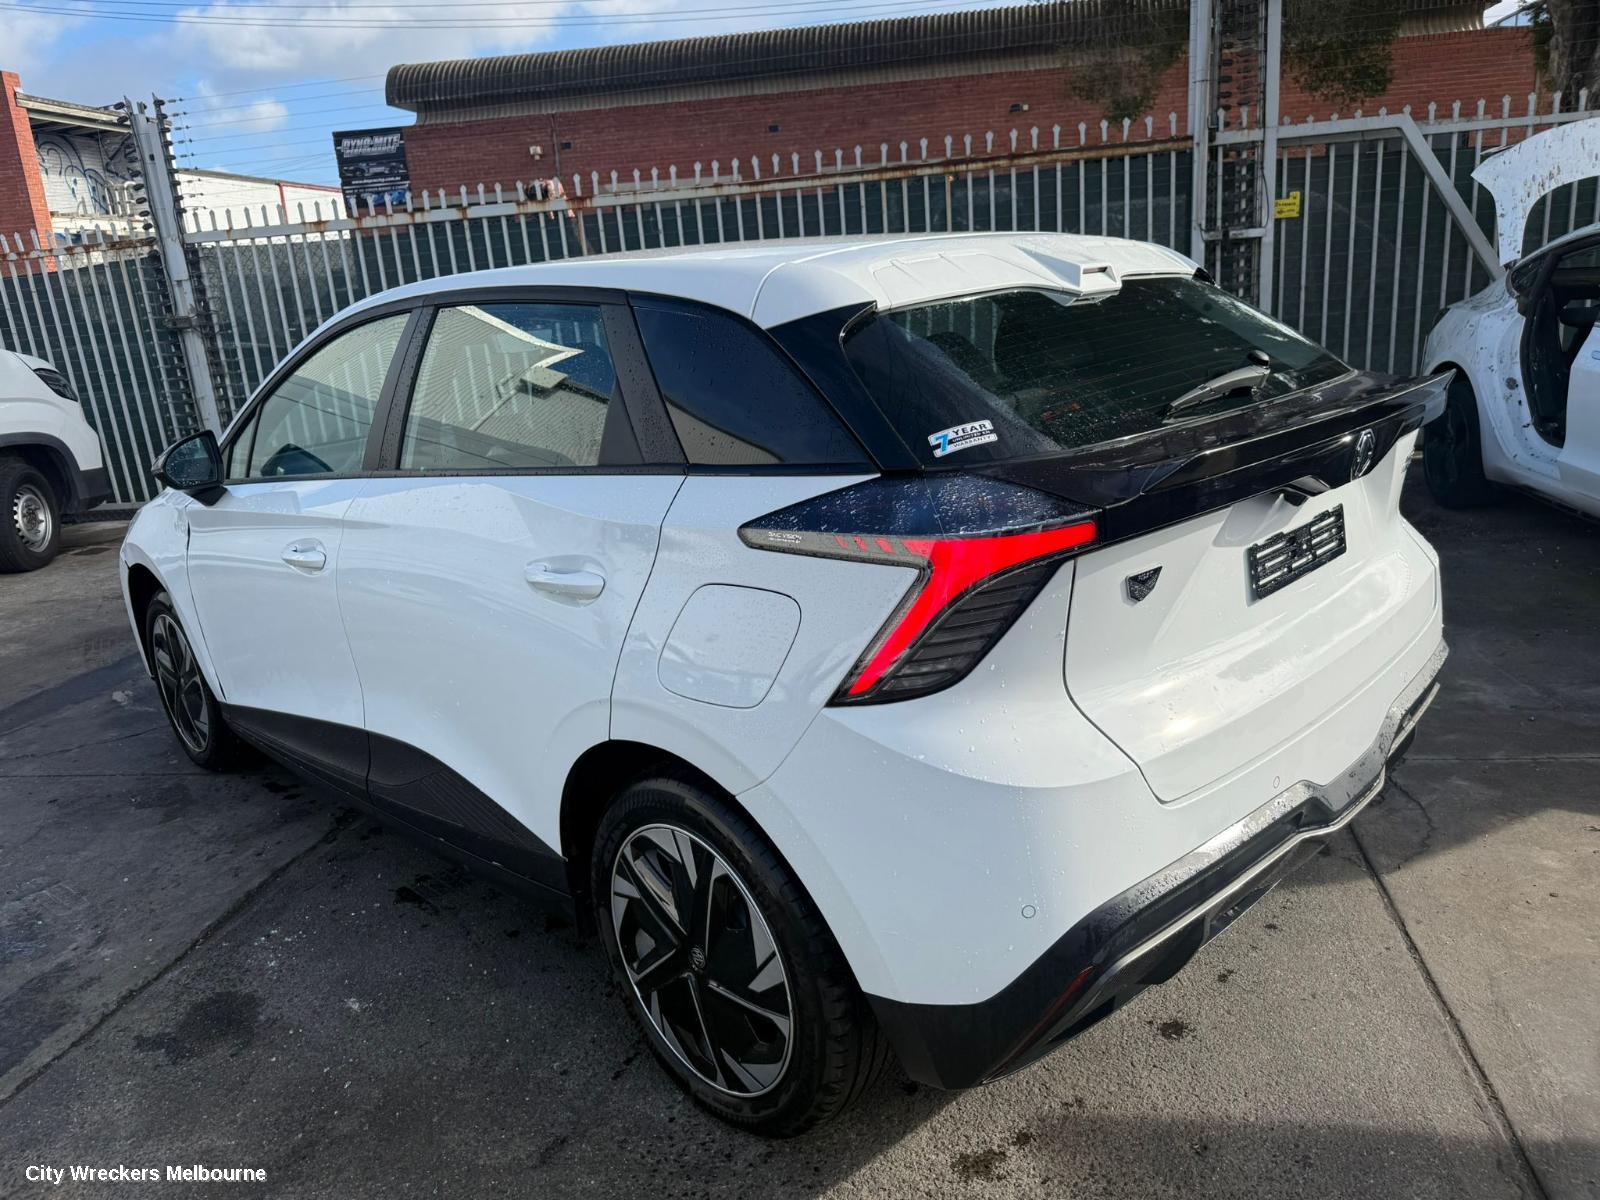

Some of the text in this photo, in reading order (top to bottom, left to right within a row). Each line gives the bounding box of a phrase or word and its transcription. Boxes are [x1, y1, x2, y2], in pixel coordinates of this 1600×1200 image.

[952, 423, 988, 436] YEAR
[935, 433, 949, 452] 7
[953, 435, 991, 448] WARRANTY
